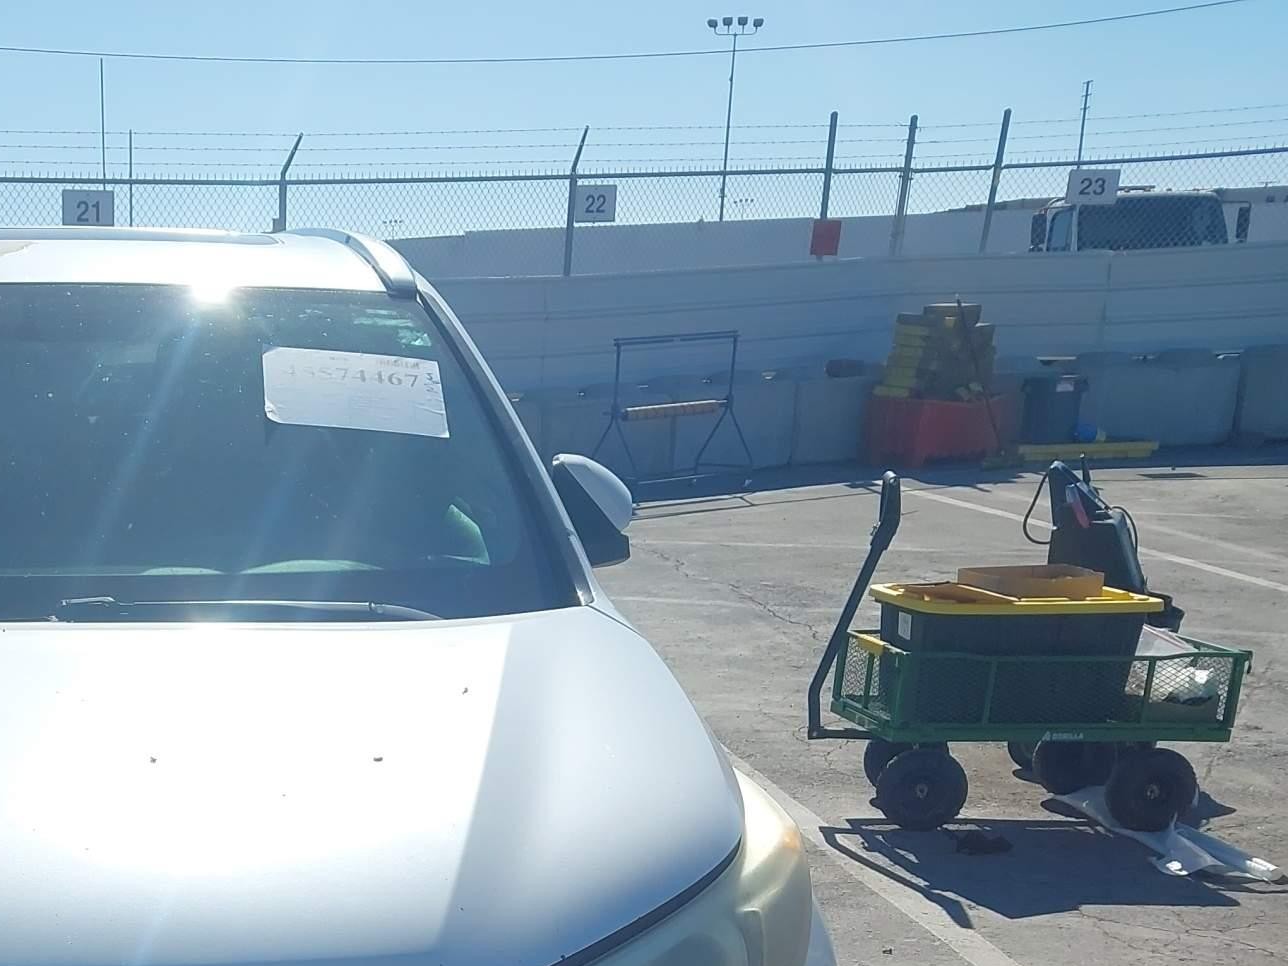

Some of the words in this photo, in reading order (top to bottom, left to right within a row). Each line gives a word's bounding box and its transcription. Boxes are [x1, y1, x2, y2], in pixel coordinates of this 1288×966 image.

[1078, 177, 1107, 196] 23
[76, 200, 100, 223] 21
[584, 194, 607, 214] 22
